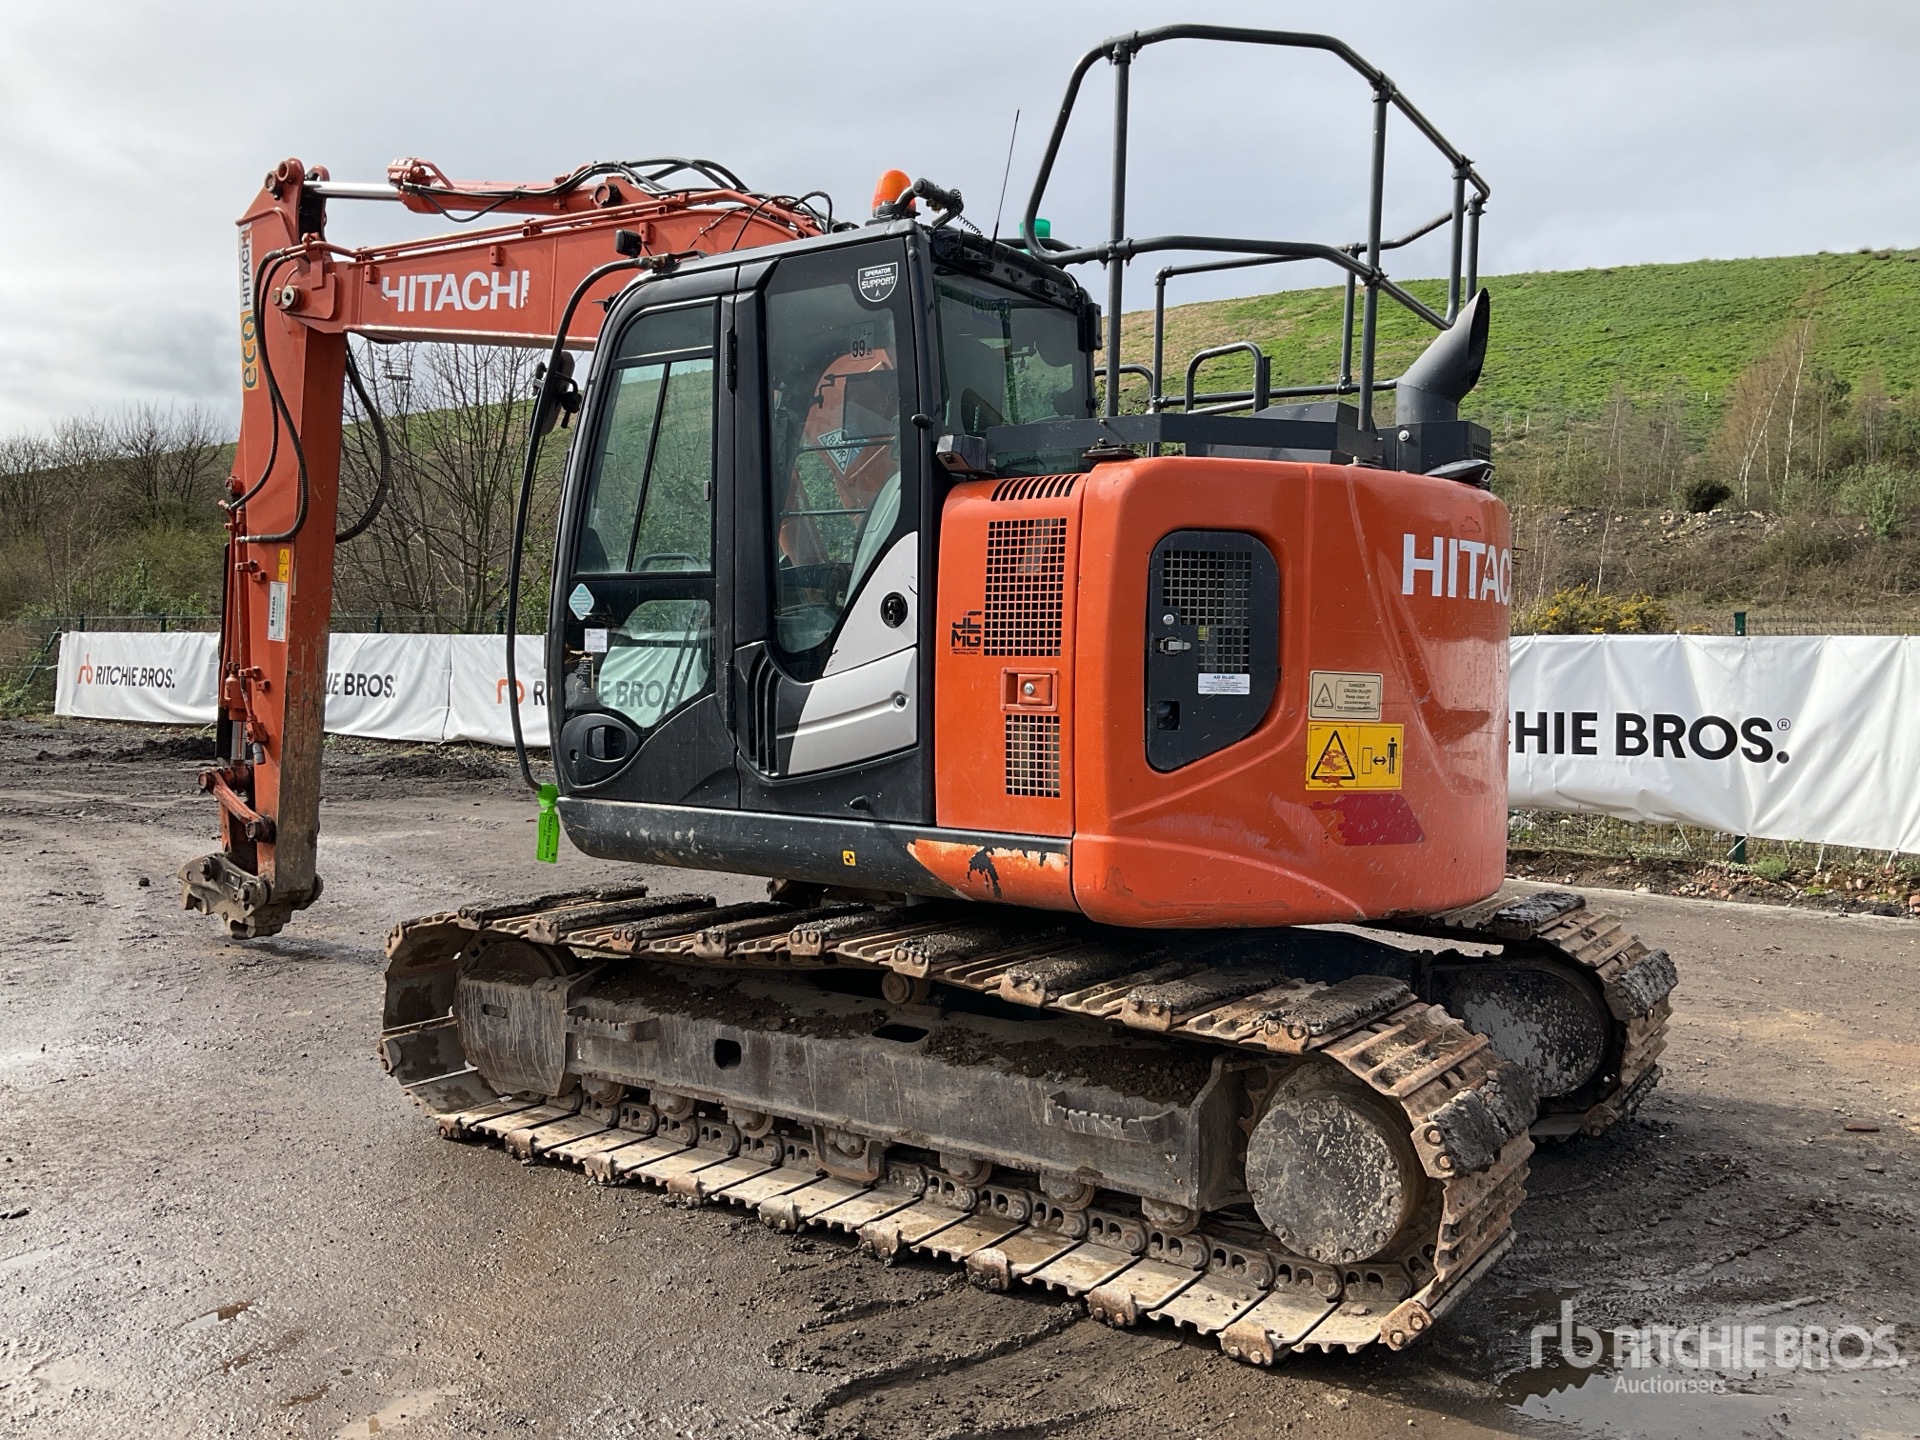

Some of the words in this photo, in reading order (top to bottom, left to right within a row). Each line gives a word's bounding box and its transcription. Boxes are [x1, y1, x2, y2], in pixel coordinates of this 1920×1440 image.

[241, 228, 251, 306] HITACH
[864, 267, 891, 277] OPERATOR
[382, 270, 530, 312] HITACHI
[861, 276, 895, 290] SUPPORT
[852, 339, 866, 357] 99
[1402, 533, 1511, 606] HITAC
[95, 665, 138, 686] RITCHIE
[138, 667, 175, 689] BROS.
[344, 672, 396, 698] BROS.
[1508, 711, 1597, 755] HIE
